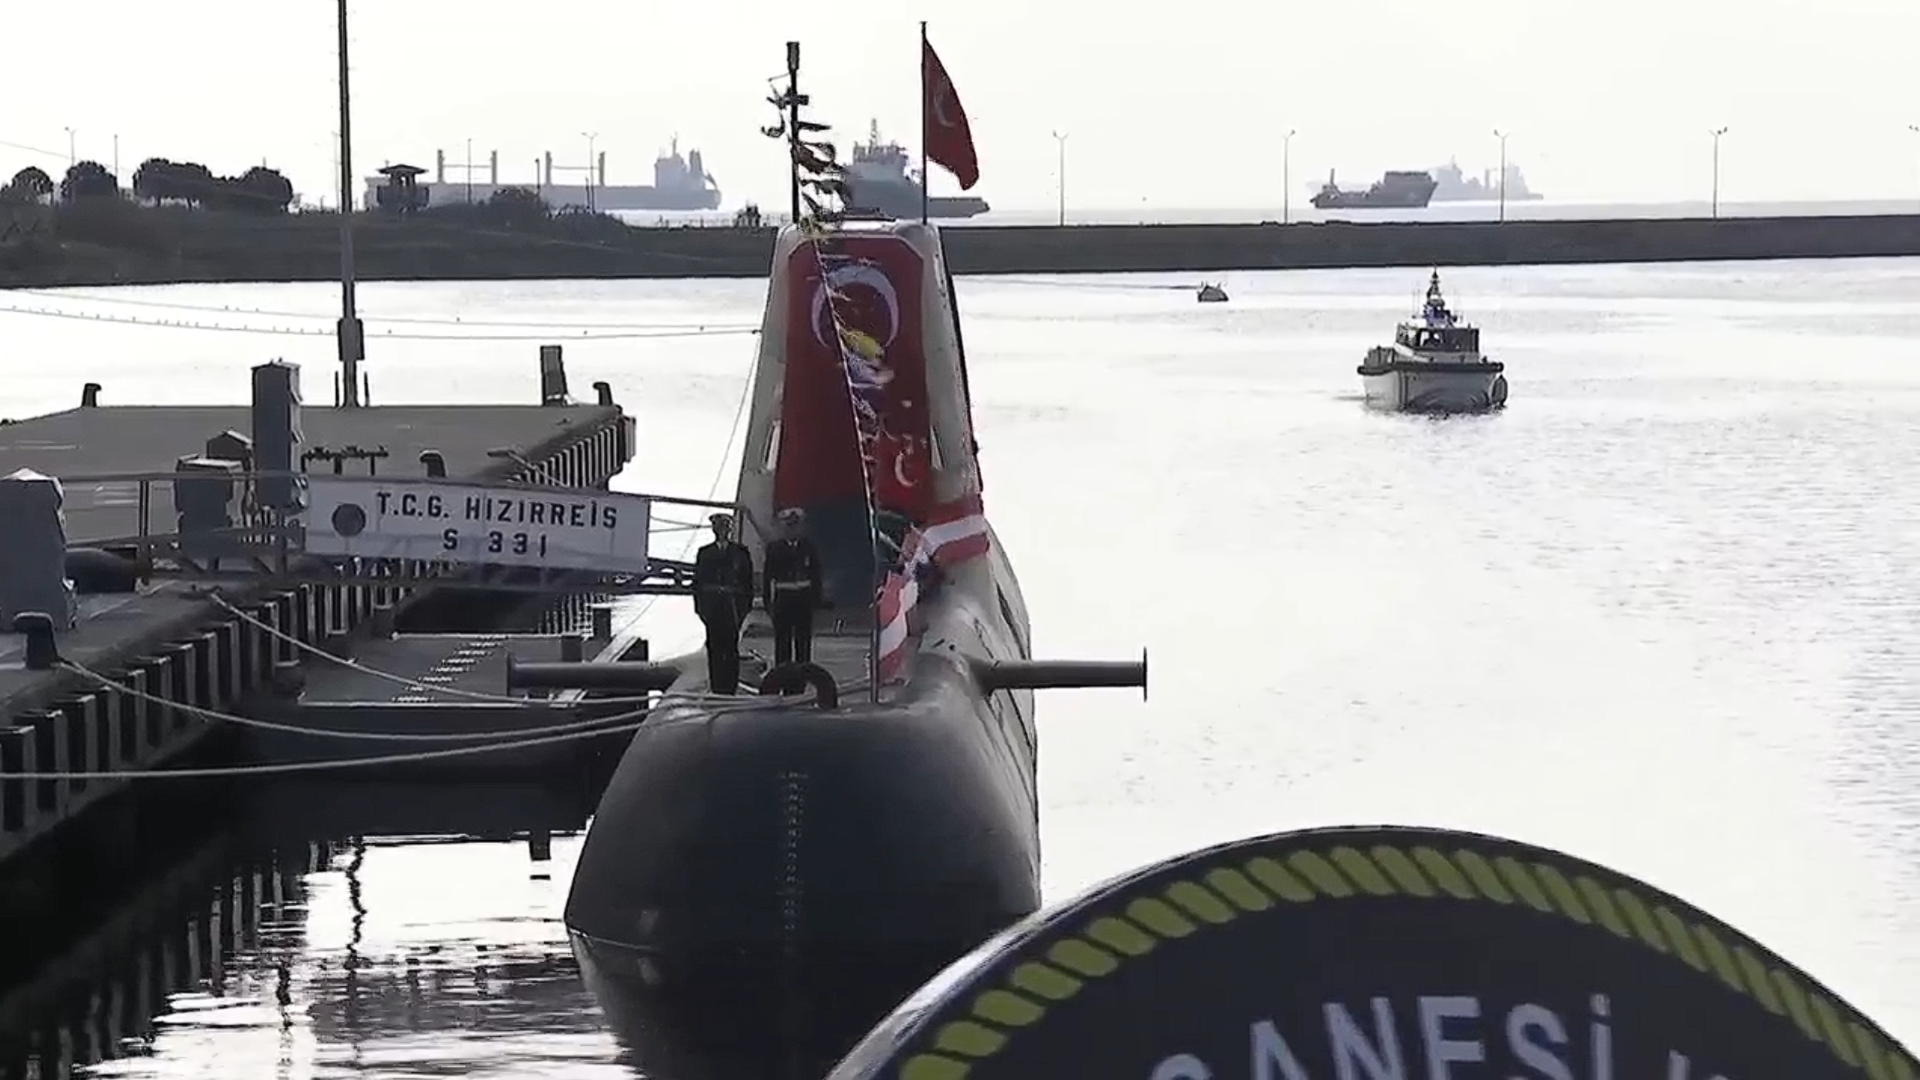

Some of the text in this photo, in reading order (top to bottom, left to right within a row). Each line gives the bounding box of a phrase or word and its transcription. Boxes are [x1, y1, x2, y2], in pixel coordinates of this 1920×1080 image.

[377, 492, 449, 517] T.C.G.
[443, 528, 547, 557] S 331
